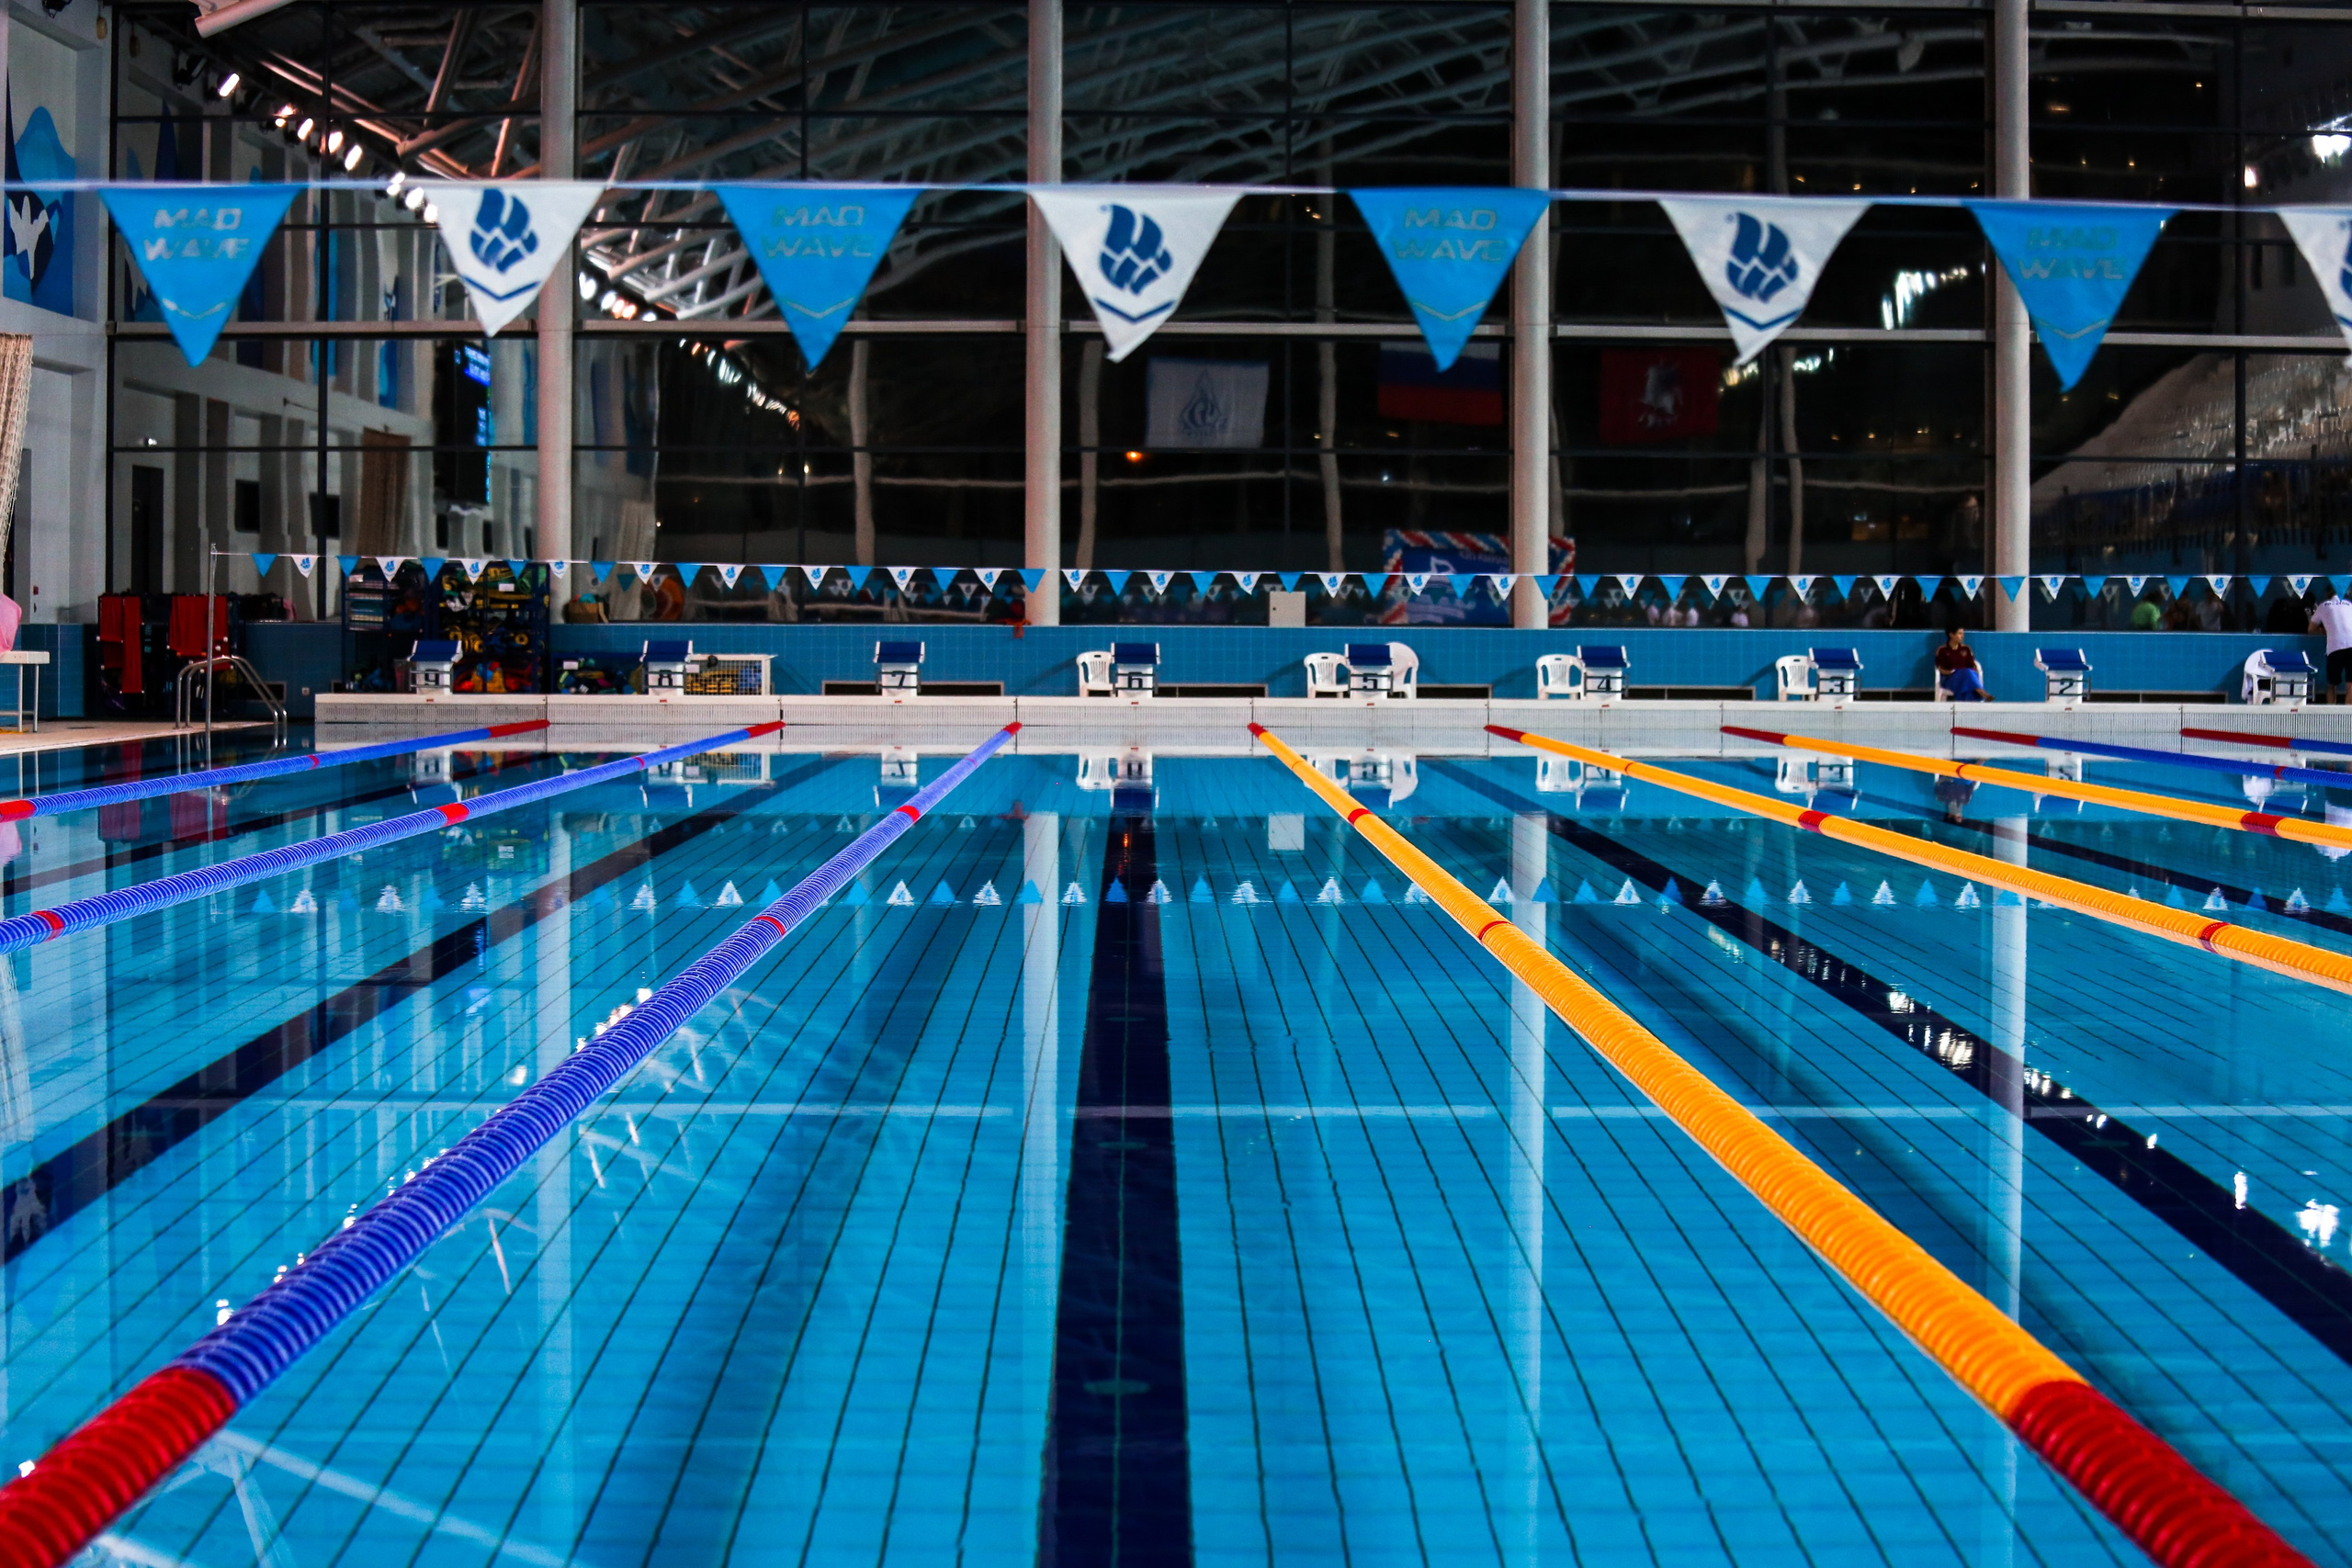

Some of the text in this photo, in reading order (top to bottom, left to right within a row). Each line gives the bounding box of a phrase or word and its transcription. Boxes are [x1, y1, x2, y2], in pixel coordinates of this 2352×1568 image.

[153, 208, 243, 231] MAD
[772, 205, 865, 228] MAD
[1403, 208, 1497, 231] MAD
[760, 235, 875, 258] WAVE
[2026, 227, 2118, 250] MAD
[1392, 238, 1507, 262] WAVE
[2018, 258, 2126, 279] WAVE
[424, 669, 440, 687] 9
[658, 669, 673, 688] 8
[891, 670, 906, 690] 7
[1127, 671, 1143, 691] 6
[1363, 672, 1378, 692] 5
[1597, 675, 1611, 694] 4
[1829, 676, 1845, 695] 3
[2059, 678, 2075, 697] 2
